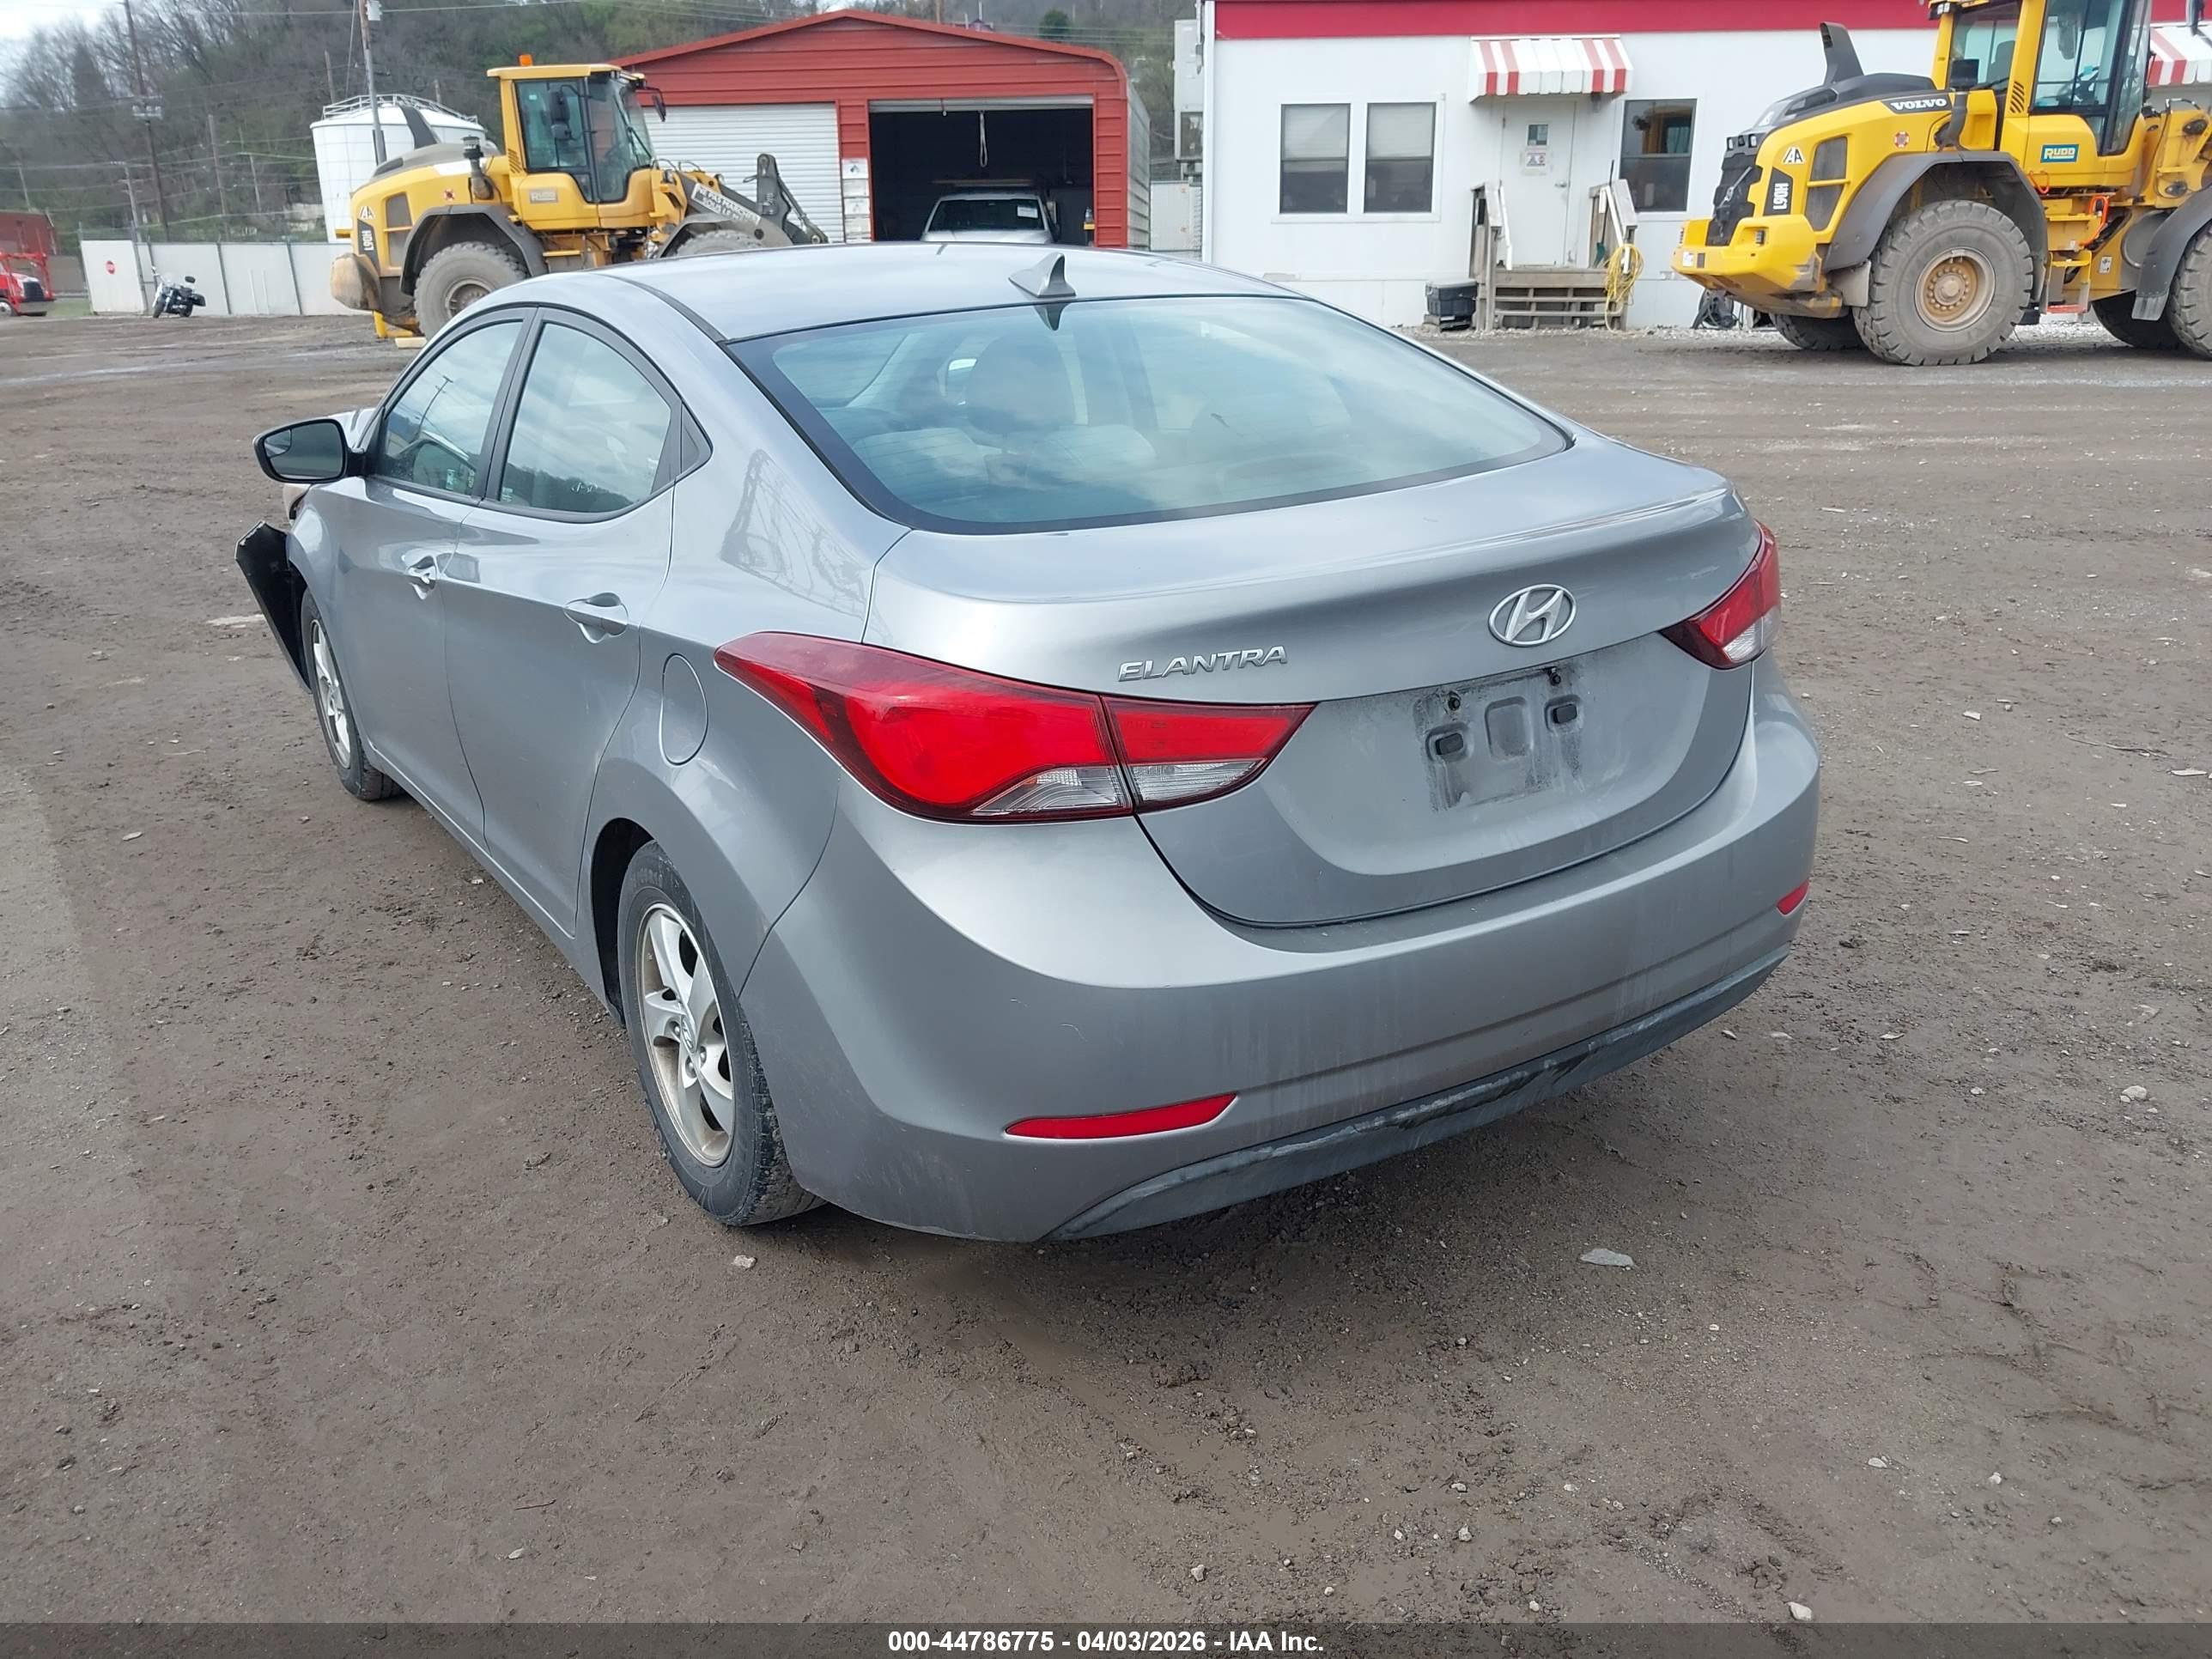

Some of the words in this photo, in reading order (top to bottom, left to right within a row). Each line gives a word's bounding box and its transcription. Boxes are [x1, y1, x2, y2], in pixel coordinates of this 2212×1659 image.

[1890, 98, 1947, 111] VOLVO
[2043, 147, 2076, 160] RUDD
[1772, 182, 1790, 210] L90H
[1118, 646, 1288, 682] ELANTRA
